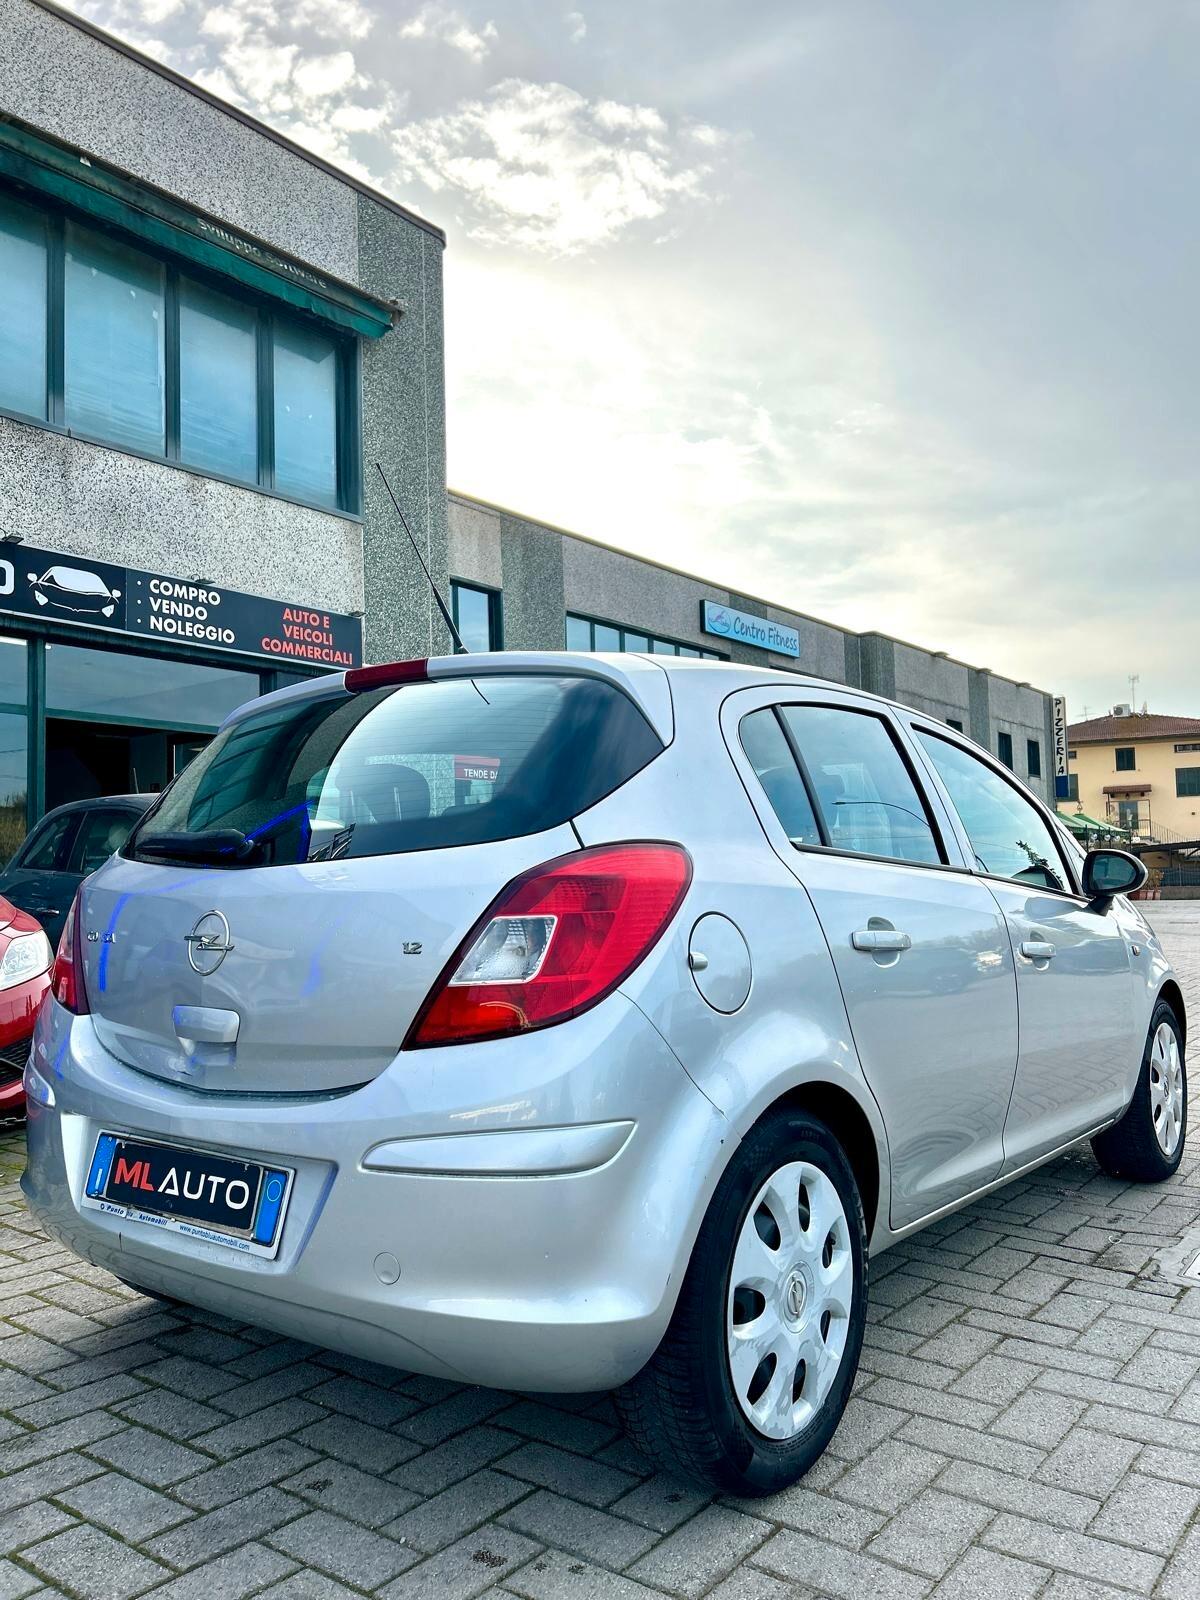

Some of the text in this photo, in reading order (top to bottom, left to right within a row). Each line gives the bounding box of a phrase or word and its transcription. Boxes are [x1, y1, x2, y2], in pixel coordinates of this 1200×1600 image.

[149, 579, 221, 606] COMPRO
[149, 597, 208, 621] VENDO
[282, 607, 330, 629] AUTO E
[149, 615, 236, 644] NOLEGGIO
[282, 623, 333, 646] VEICOLI
[734, 616, 766, 641] Centro
[768, 626, 798, 651] Fitness
[261, 637, 353, 665] COMMERCIALI
[1054, 698, 1064, 776] PIZZERIA
[464, 768, 488, 779] TENDE
[139, 1213, 168, 1226] Automobili
